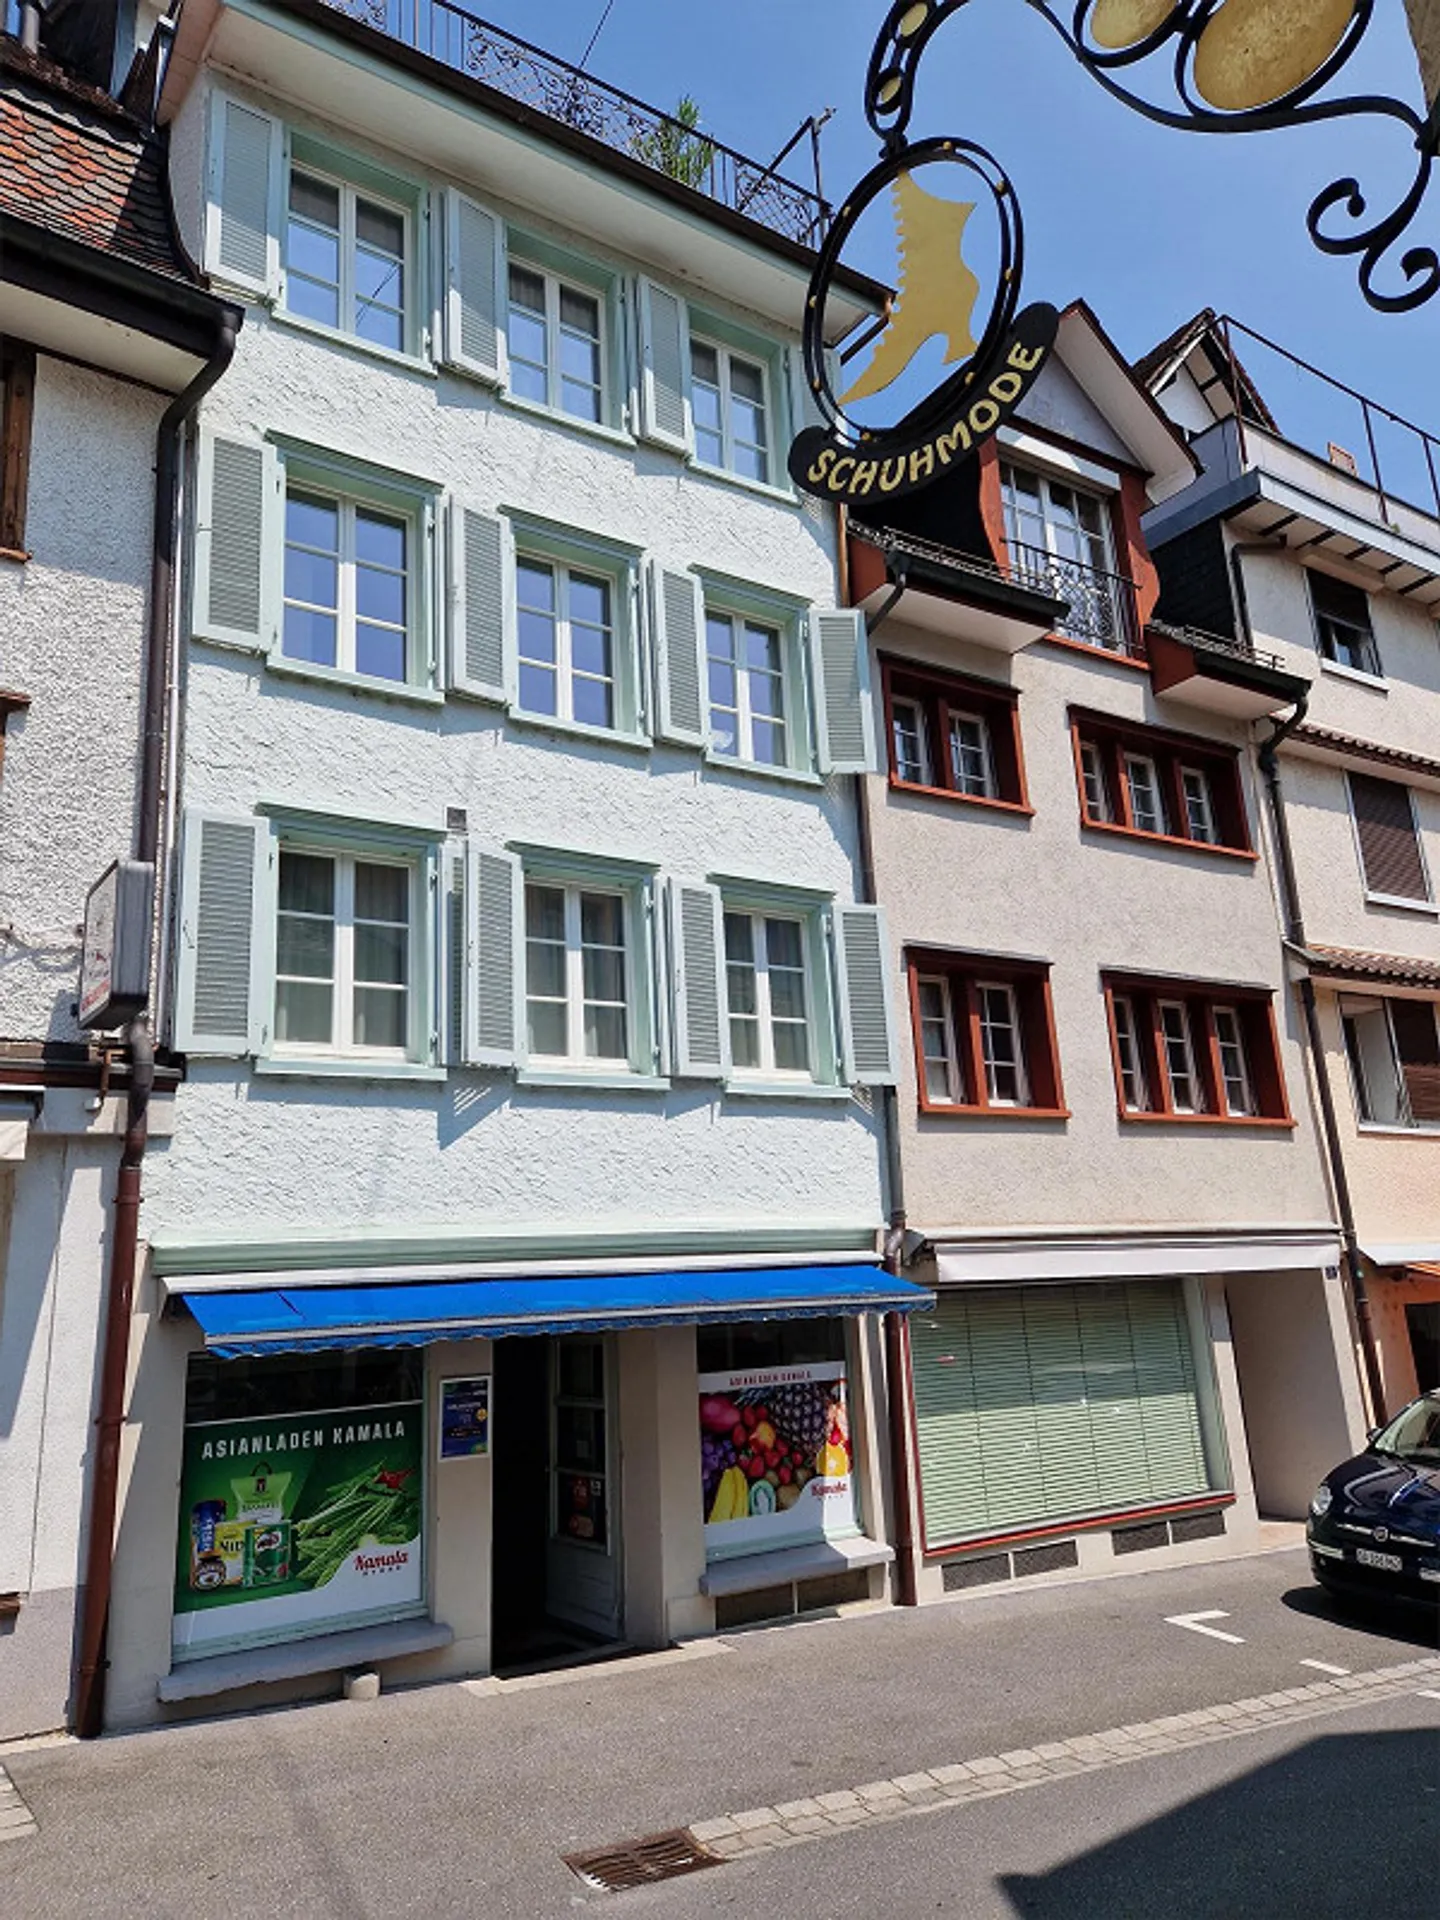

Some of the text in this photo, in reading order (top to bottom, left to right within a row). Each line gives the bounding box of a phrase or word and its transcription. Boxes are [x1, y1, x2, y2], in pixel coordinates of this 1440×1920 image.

[807, 341, 1044, 496] SCHUHMODE
[201, 1420, 405, 1460] ASIANLADEN KAMALA
